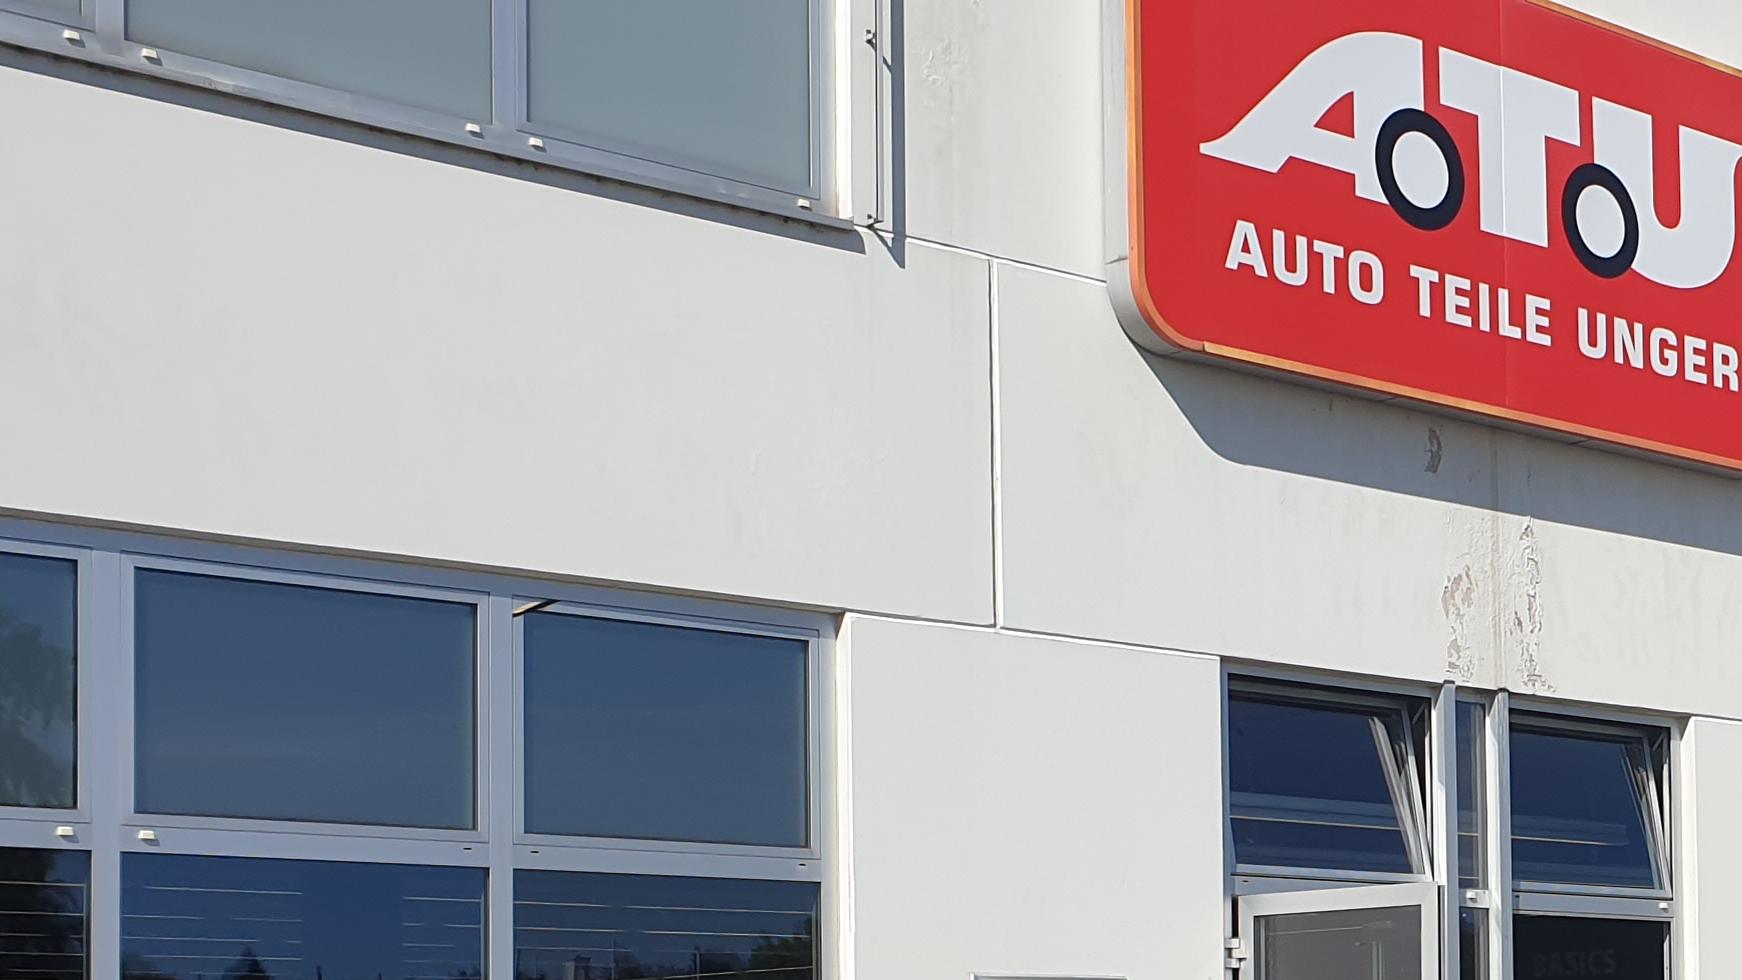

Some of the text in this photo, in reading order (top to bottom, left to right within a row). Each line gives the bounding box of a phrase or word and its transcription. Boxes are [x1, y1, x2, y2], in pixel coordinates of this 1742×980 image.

[1225, 220, 1741, 393] AUTO TEILE UNGER
[1534, 950, 1616, 977] BASICS
